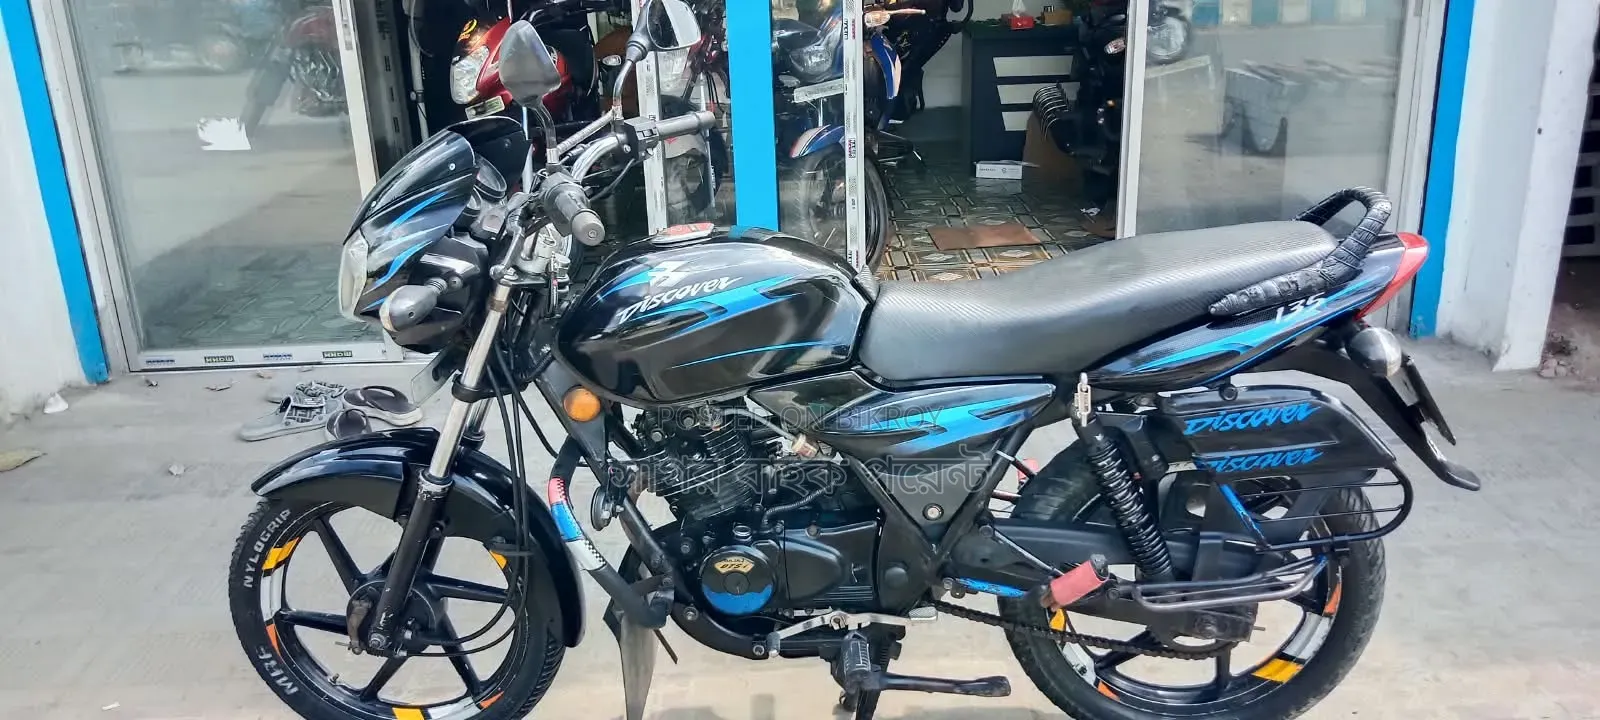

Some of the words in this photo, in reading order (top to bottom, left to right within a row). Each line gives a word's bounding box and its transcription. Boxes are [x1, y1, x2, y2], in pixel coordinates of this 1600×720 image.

[616, 277, 743, 324] Discover
[1275, 292, 1325, 325] 135
[1183, 402, 1321, 435] Discover
[243, 509, 291, 588] NYLOGRIP
[256, 645, 299, 695] MRF
